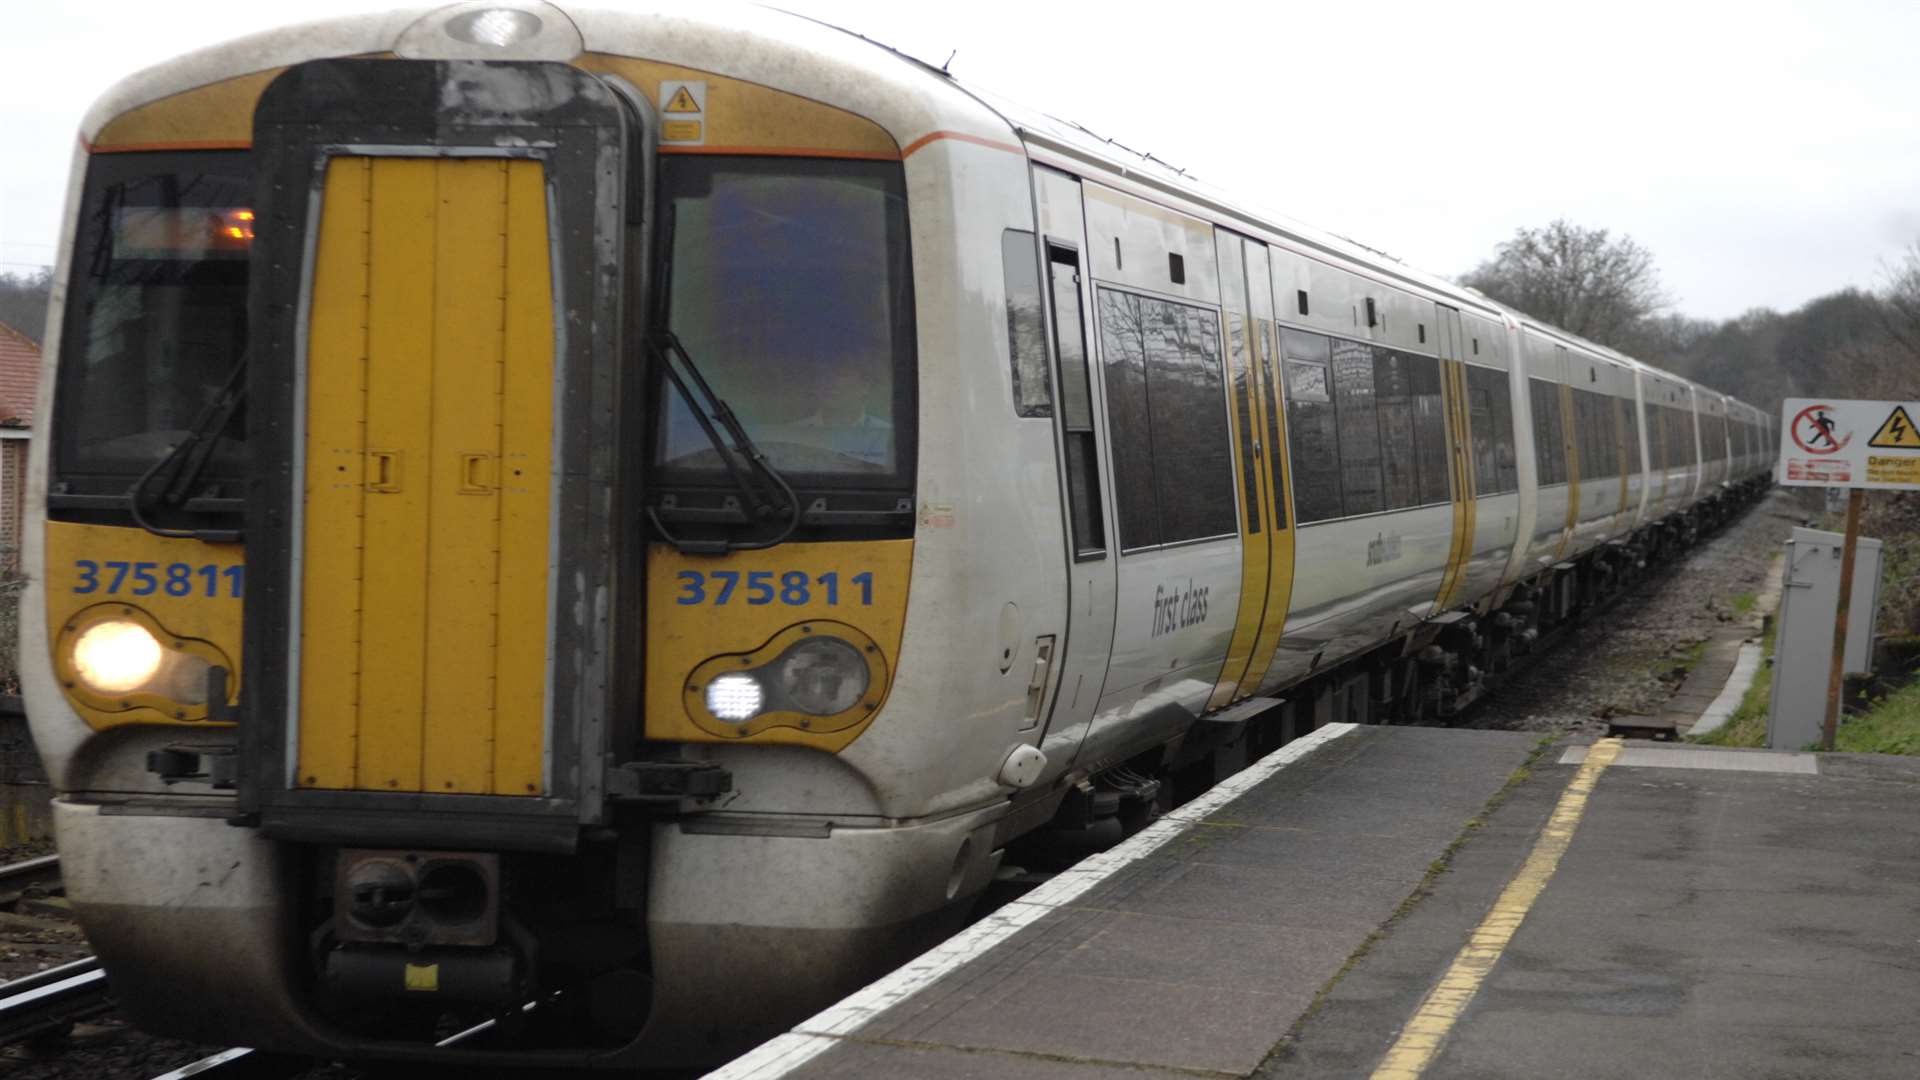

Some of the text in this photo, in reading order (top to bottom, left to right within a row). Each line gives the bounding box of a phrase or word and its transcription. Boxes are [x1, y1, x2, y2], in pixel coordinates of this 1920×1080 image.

[1868, 456, 1916, 468] Danger
[72, 560, 246, 598] 375811
[676, 570, 873, 606] 375811
[1152, 577, 1209, 638] first class
